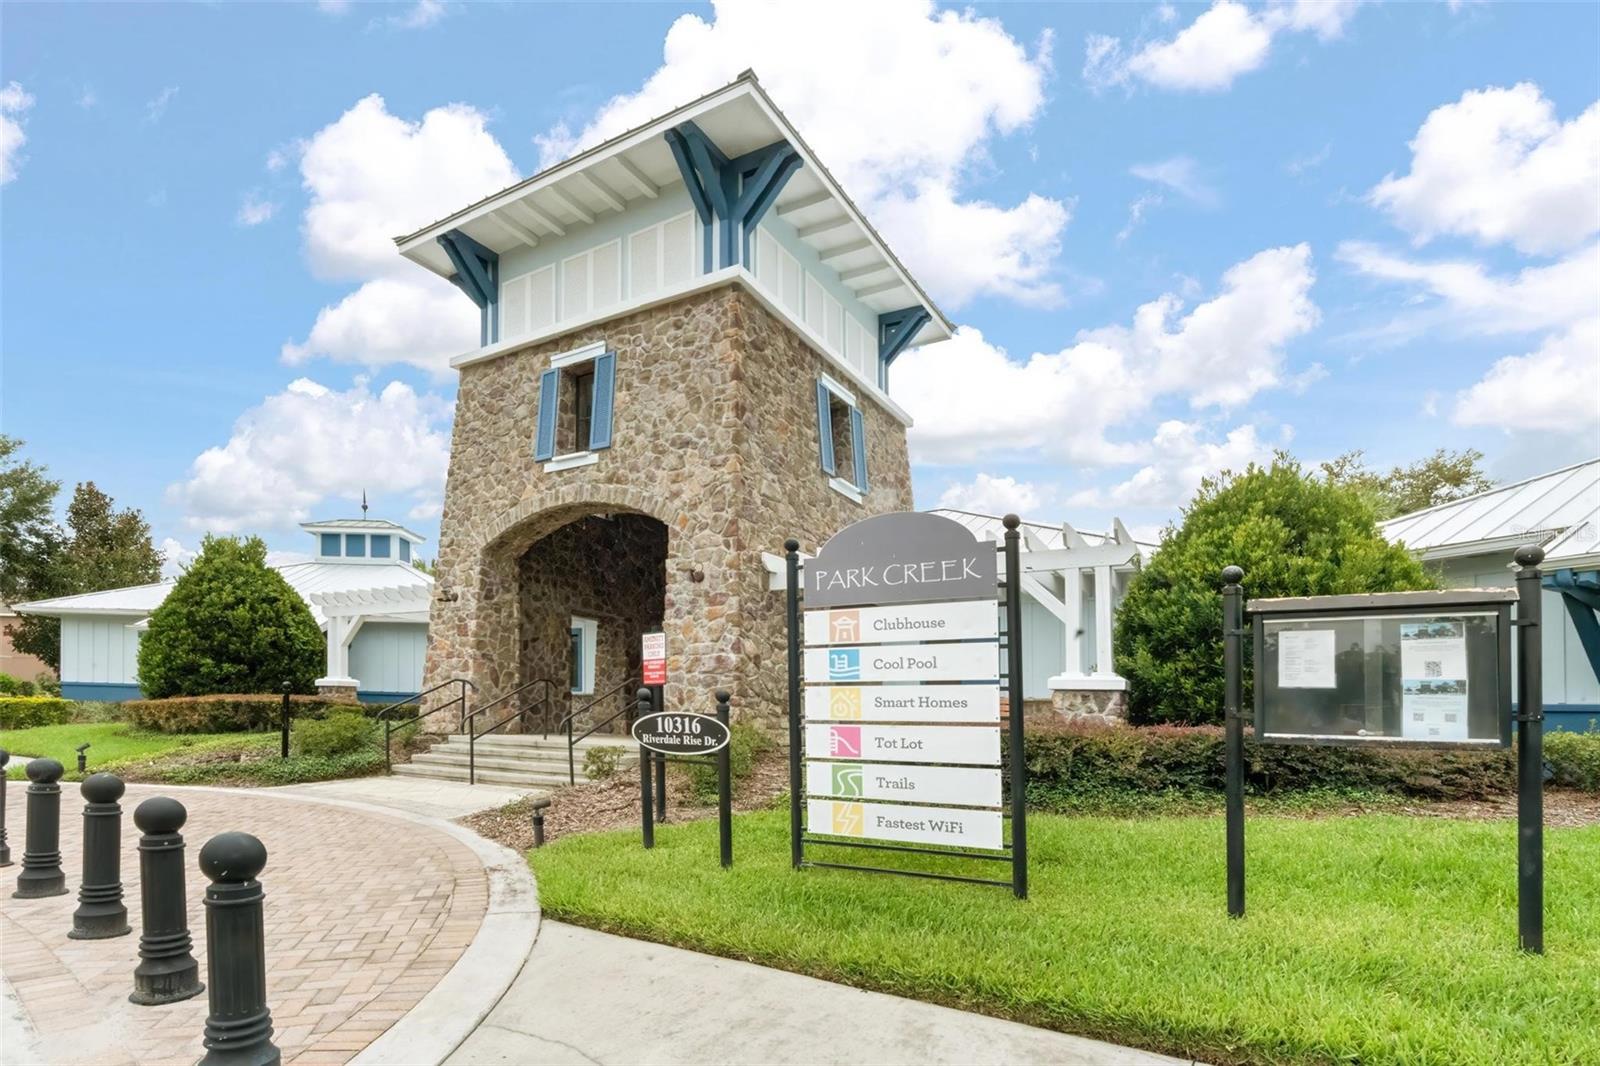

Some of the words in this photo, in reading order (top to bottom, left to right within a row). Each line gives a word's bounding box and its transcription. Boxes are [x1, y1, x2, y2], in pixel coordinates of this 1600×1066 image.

[816, 567, 878, 590] PARK
[883, 558, 981, 585] CREEK
[873, 617, 946, 632] Clubhouse
[872, 657, 904, 670] Cool
[907, 656, 938, 670] Pool
[874, 696, 916, 708] Smart
[918, 696, 969, 709] Homes
[656, 717, 701, 734] 10316
[642, 734, 680, 745] Riverdale
[683, 735, 702, 745] Rise
[704, 736, 718, 746] Dr.
[874, 737, 898, 749] Tot
[901, 738, 924, 750] Lot
[875, 777, 916, 791] Trails
[876, 816, 926, 831] Fastest
[927, 820, 964, 834] WiFi
